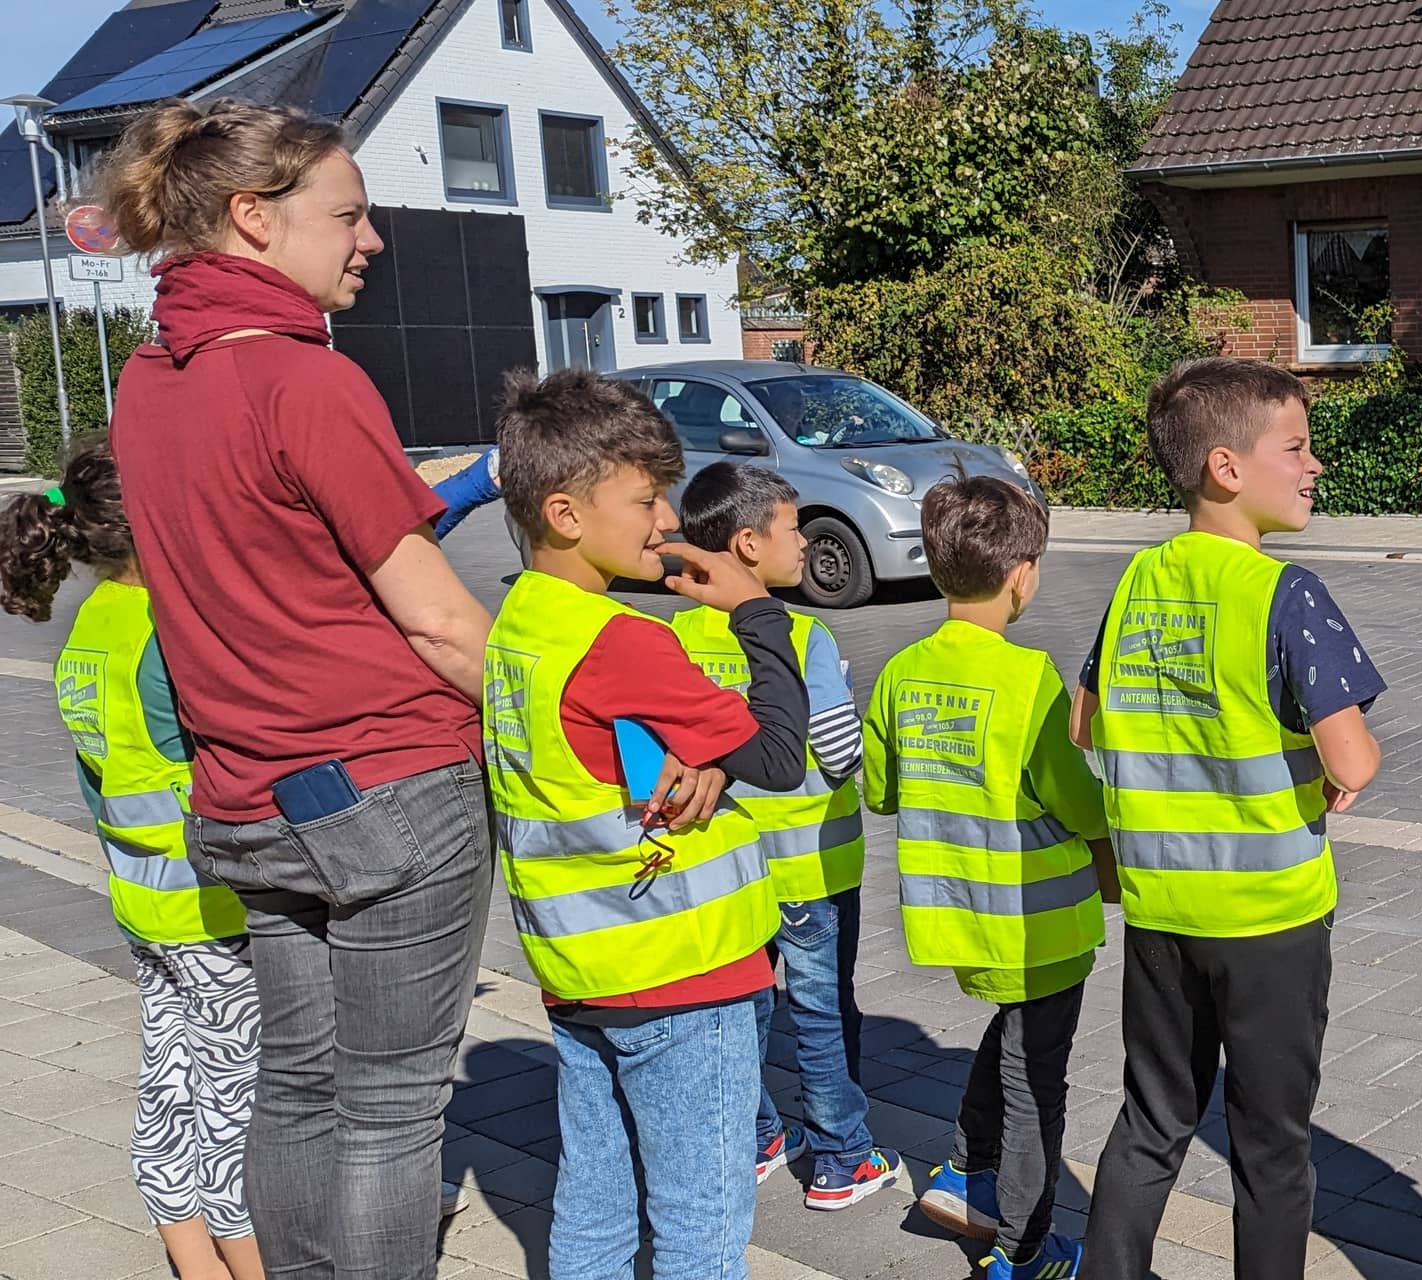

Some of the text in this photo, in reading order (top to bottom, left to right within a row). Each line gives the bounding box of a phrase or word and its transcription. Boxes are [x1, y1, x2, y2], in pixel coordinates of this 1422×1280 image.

[81, 259, 111, 268] Mo-Fr
[618, 307, 625, 319] 2
[1124, 611, 1206, 630] ANTENNE
[900, 690, 980, 711] ANTENNE
